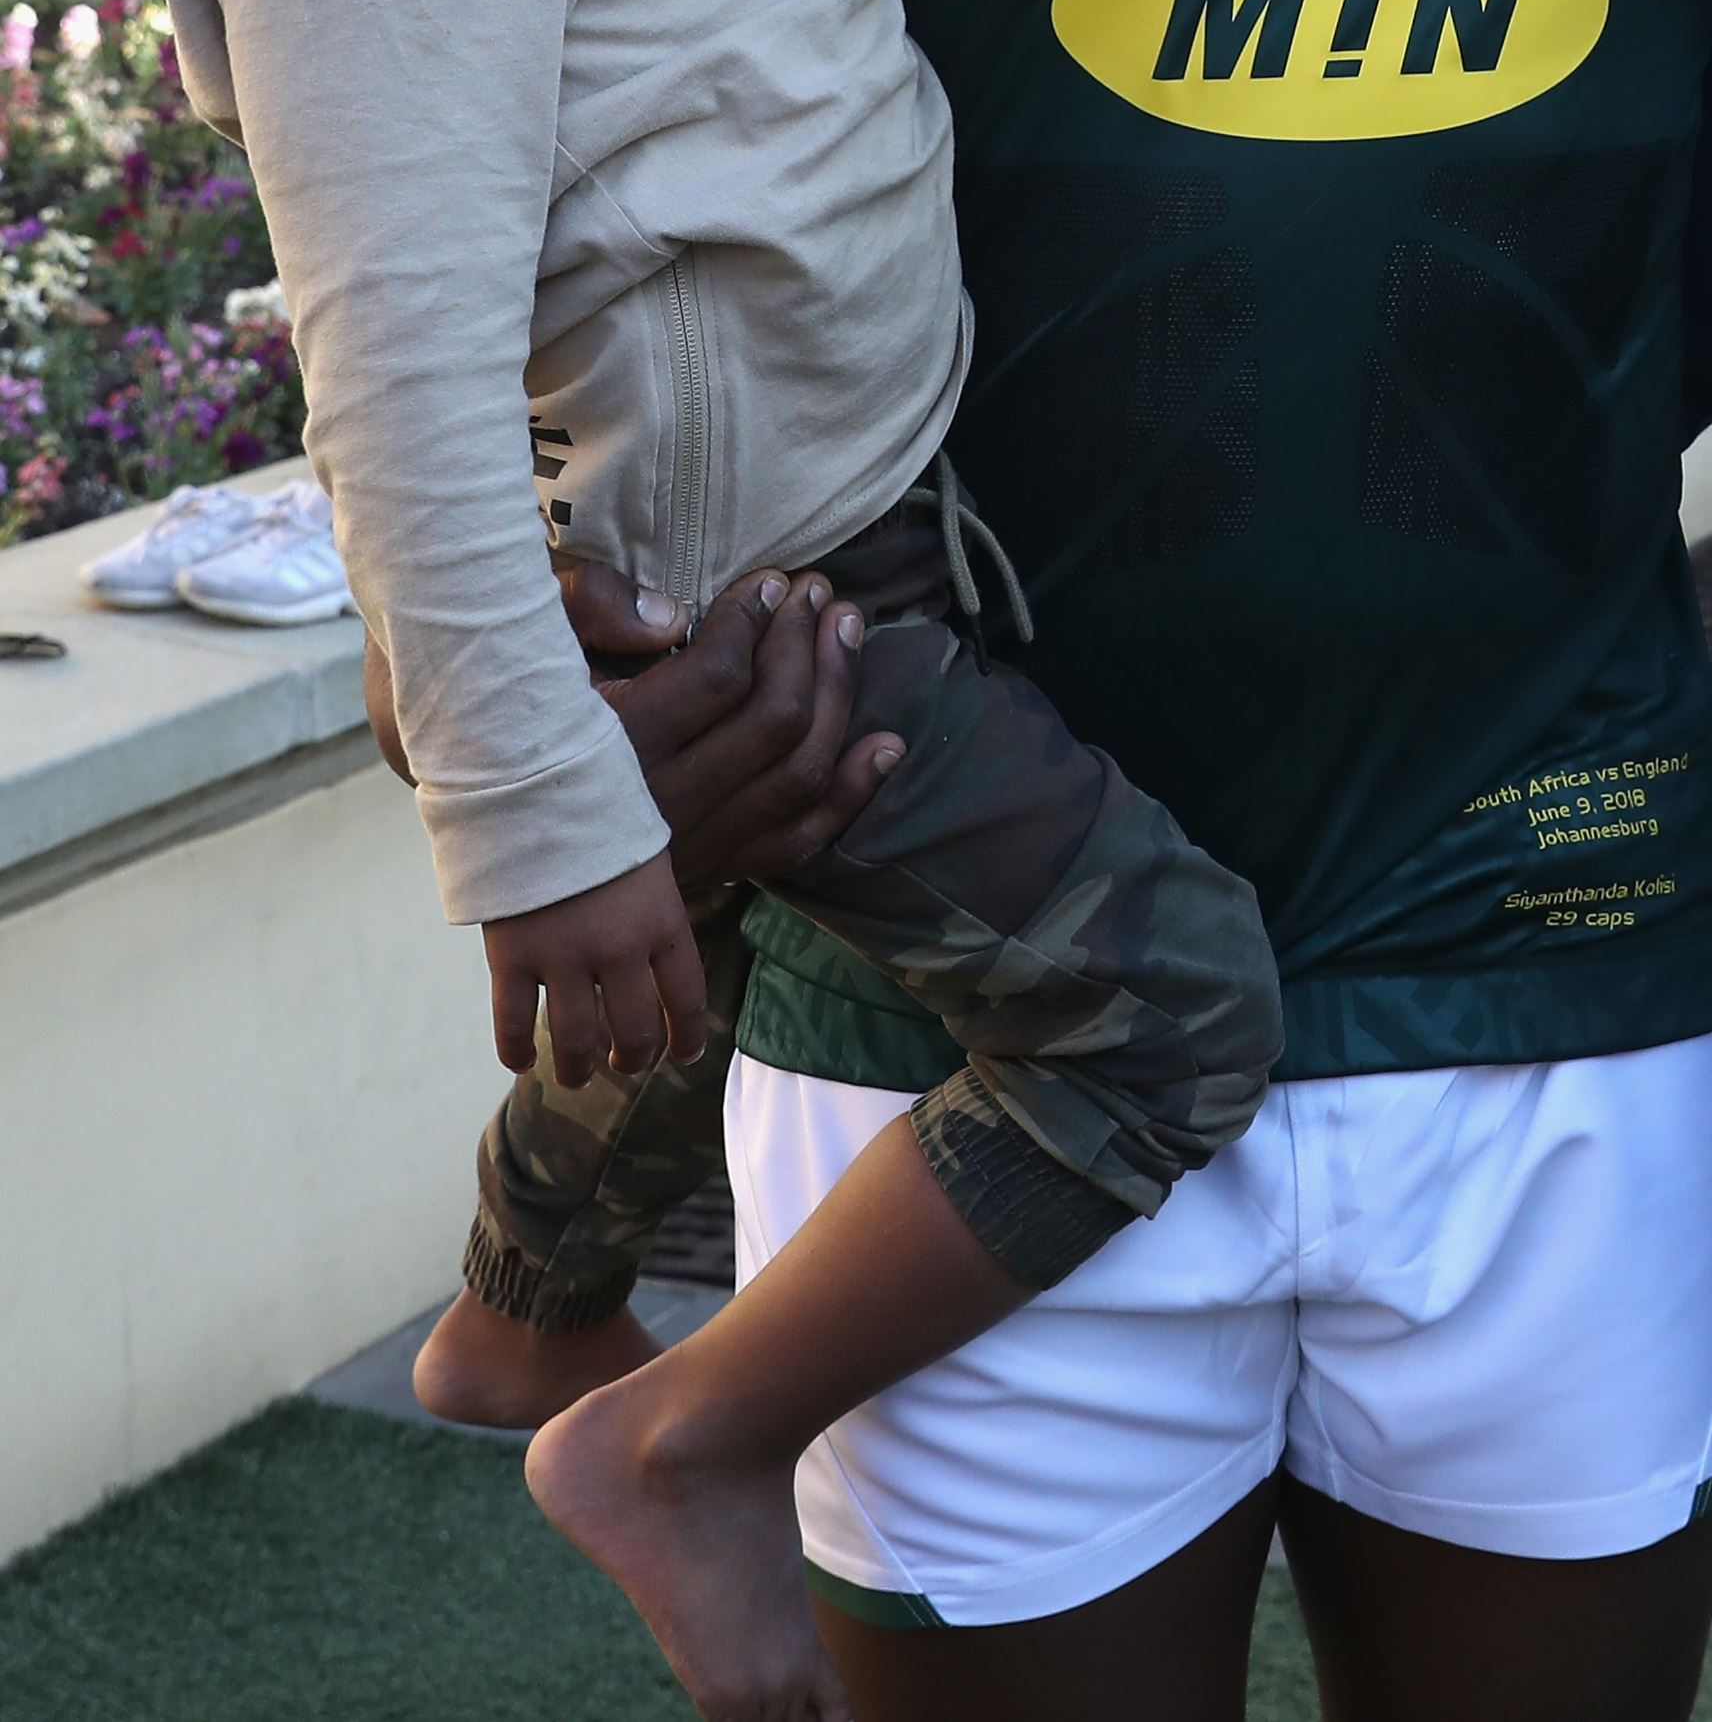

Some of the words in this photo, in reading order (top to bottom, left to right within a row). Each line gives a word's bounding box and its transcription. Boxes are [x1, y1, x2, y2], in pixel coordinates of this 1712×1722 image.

[1529, 770, 1592, 798] Africa
[1594, 766, 1619, 783] vs
[1622, 752, 1689, 780] England
[1528, 807, 1572, 827] June
[1576, 796, 1598, 815] 9,
[1600, 788, 1646, 811] 2018
[1537, 818, 1659, 850] Johannesburg
[1504, 883, 1629, 911] Siyamthanda
[1634, 872, 1676, 898] Kolisi
[1546, 910, 1579, 927] 29
[1585, 911, 1636, 931] caps
